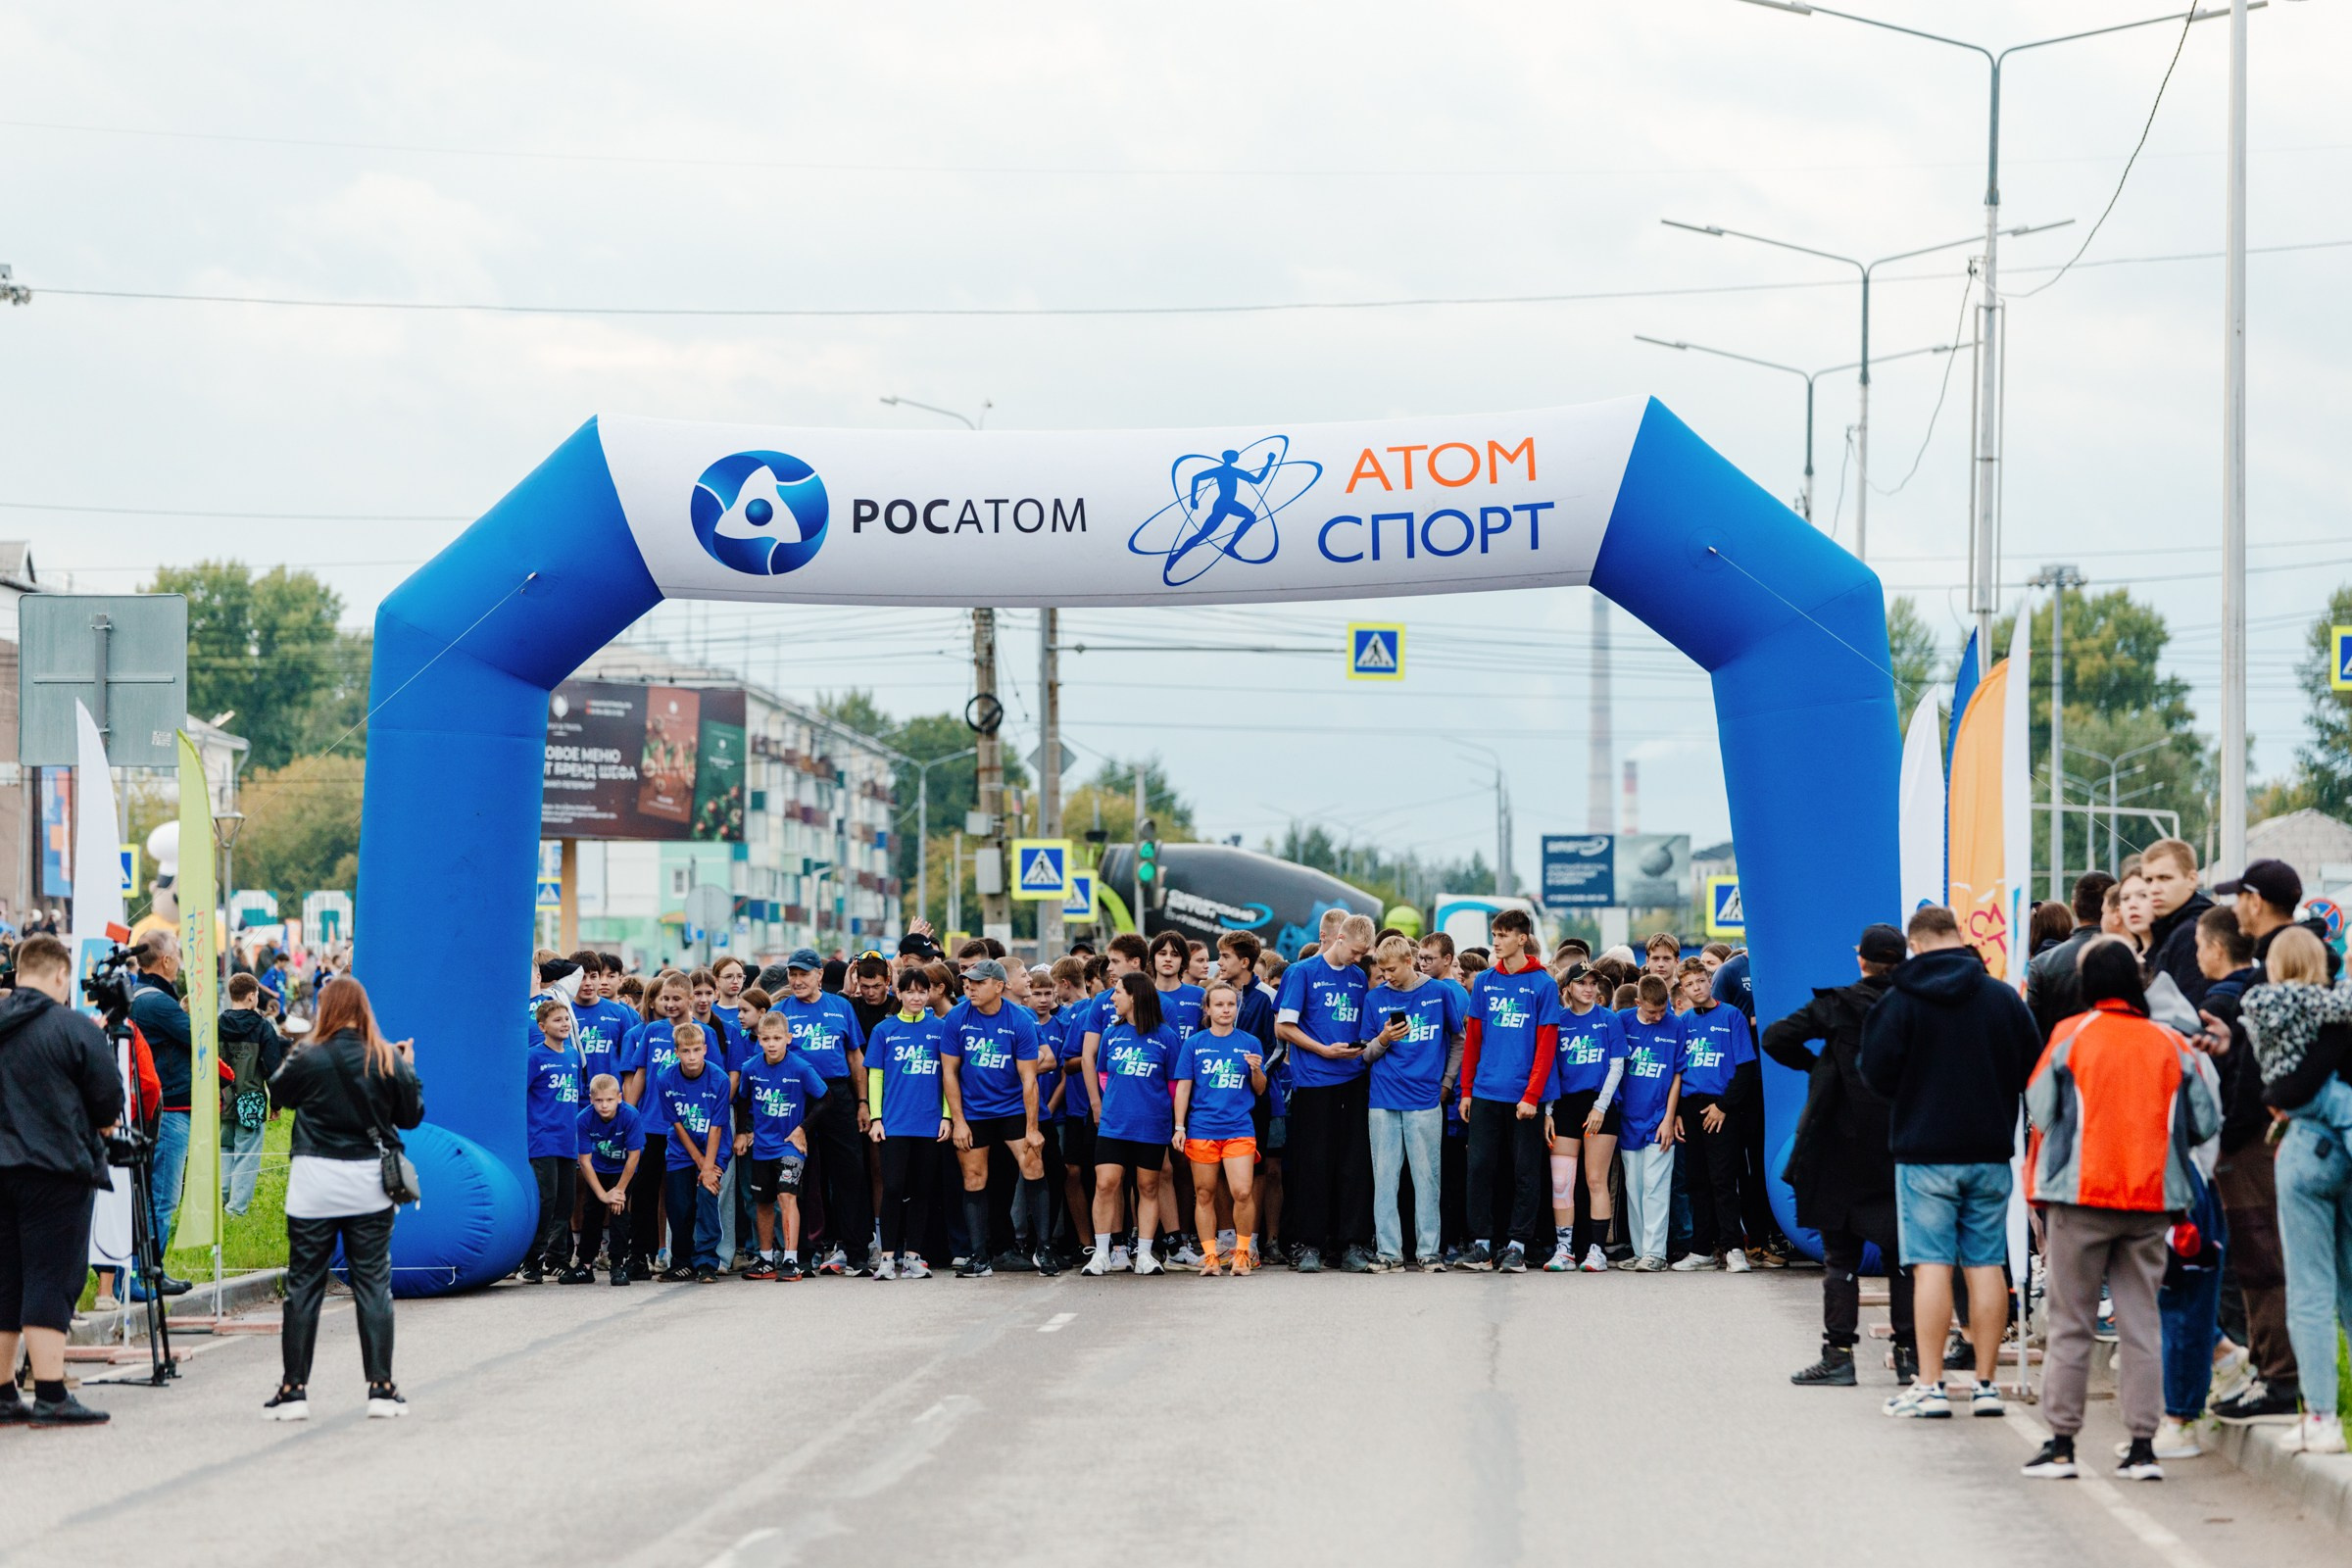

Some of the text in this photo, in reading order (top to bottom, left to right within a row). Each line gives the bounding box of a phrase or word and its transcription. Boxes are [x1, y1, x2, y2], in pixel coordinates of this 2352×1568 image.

[1345, 436, 1537, 494] АТОМ
[853, 497, 1087, 535] РОСАТОМ
[1317, 501, 1555, 564] СПОРТ
[545, 745, 621, 763] ОВОЕ МЕНЮ
[598, 764, 638, 781] ШЕФА
[1324, 992, 1348, 1007] ЗА!
[1489, 997, 1514, 1012] ЗА!
[1338, 1006, 1359, 1022] БЕГ
[1500, 1013, 1530, 1028] БЕГ
[579, 1025, 598, 1040] А!
[792, 1022, 821, 1038] ЗА!
[1408, 1024, 1440, 1043] БЕГ
[584, 1039, 612, 1054] БЕГ
[810, 1035, 840, 1051] БЕГ
[964, 1036, 994, 1053] ЗА!
[1560, 1035, 1589, 1052] ЗА!
[1686, 1037, 1706, 1054] ЗА!
[894, 1045, 923, 1061] ЗА!
[978, 1054, 1011, 1068] БЕГ
[1111, 1047, 1142, 1061] ЗА!
[1576, 1048, 1605, 1064] БЕГ
[1693, 1053, 1725, 1067] БЕГ
[910, 1059, 940, 1074] БЕГ
[1123, 1061, 1157, 1077] БЕГ
[1201, 1058, 1232, 1074] ЗА!
[1635, 1061, 1667, 1078] БЕГ
[548, 1073, 572, 1088] ЗА!
[562, 1088, 579, 1102] БЕ
[755, 1086, 780, 1102] ЗА!
[767, 1102, 797, 1117] БЕГ
